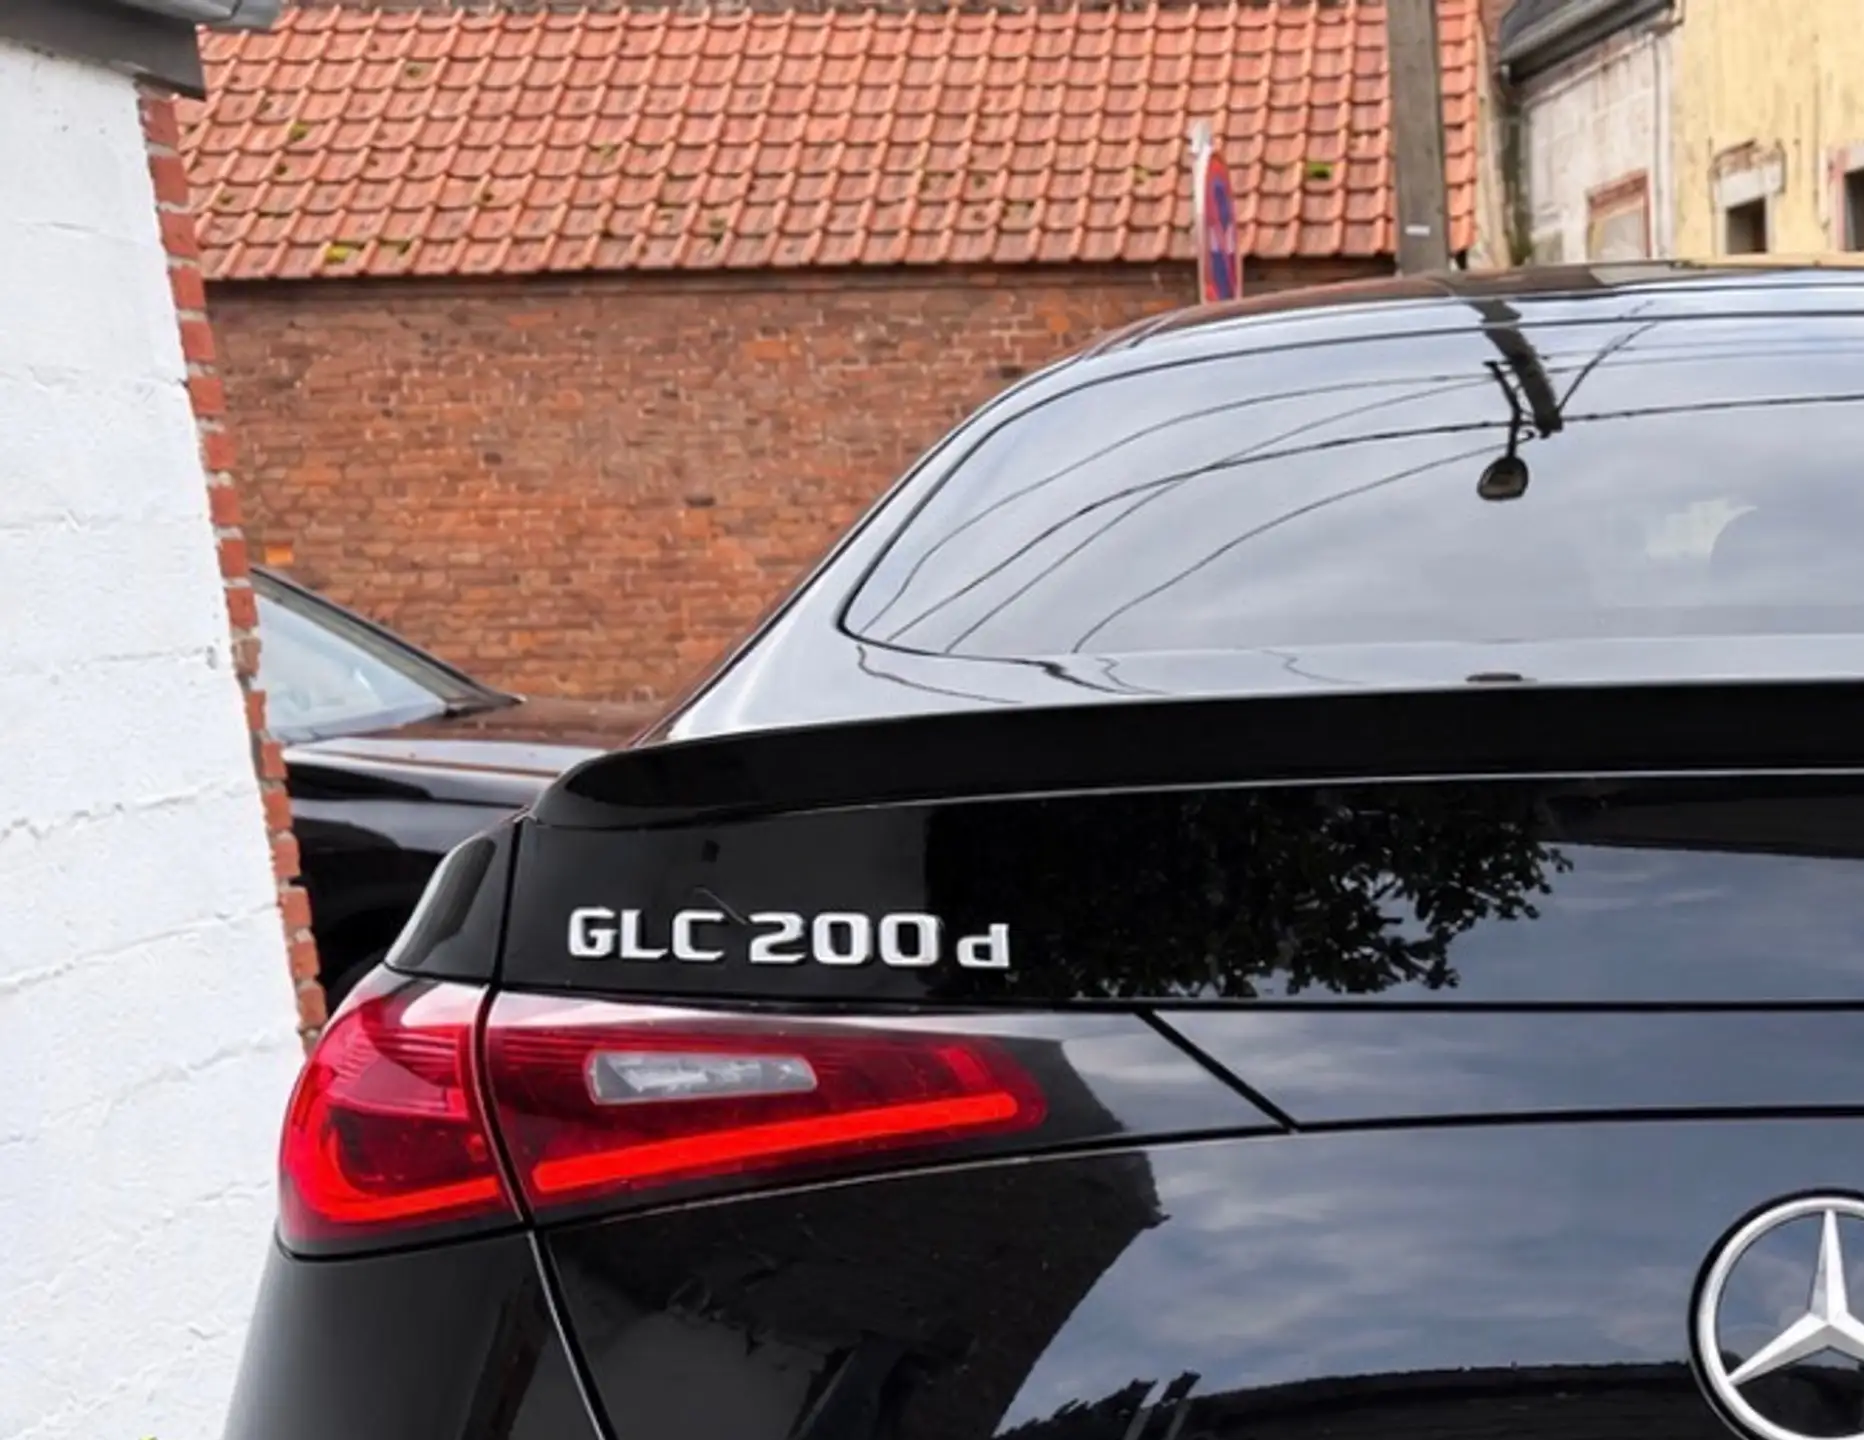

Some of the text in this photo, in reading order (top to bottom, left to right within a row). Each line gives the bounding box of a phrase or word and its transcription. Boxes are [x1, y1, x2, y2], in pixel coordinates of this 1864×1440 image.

[568, 907, 1011, 968] GLC 200 d
